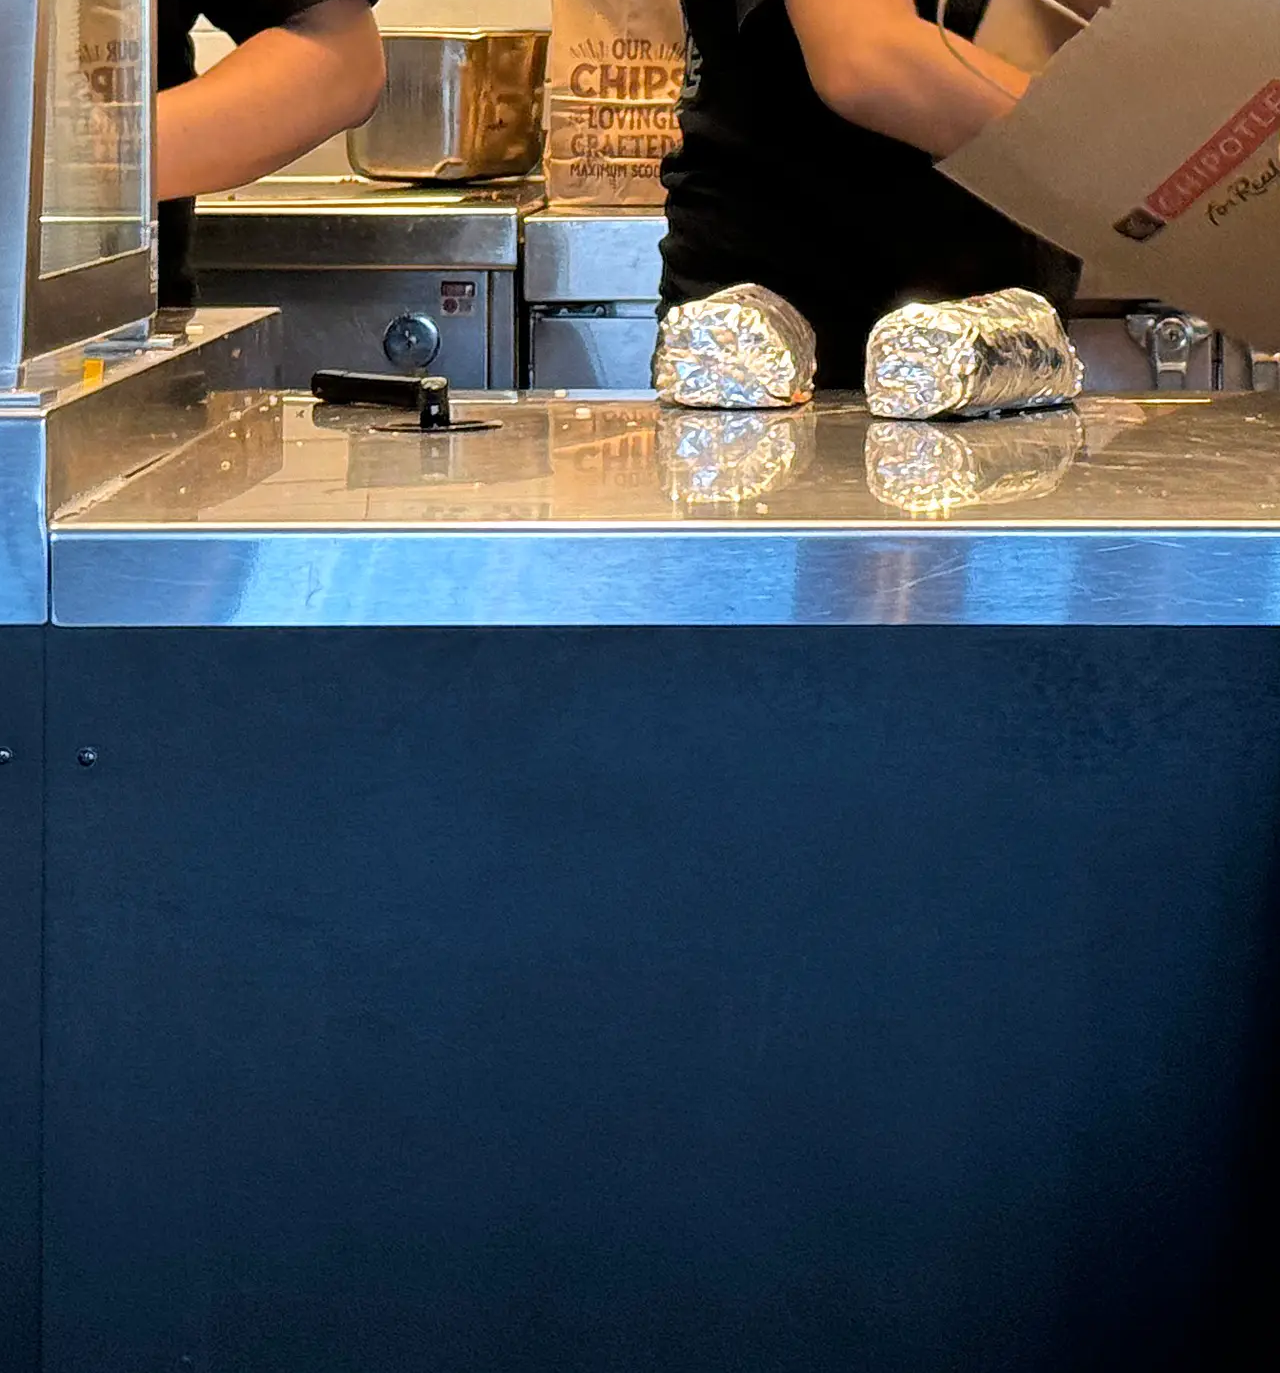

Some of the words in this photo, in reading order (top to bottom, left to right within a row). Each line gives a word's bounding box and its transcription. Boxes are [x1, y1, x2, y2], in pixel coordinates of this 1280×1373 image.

[612, 38, 653, 61] OUR
[570, 63, 685, 101] CHIPS
[587, 106, 680, 130] LOVINGL
